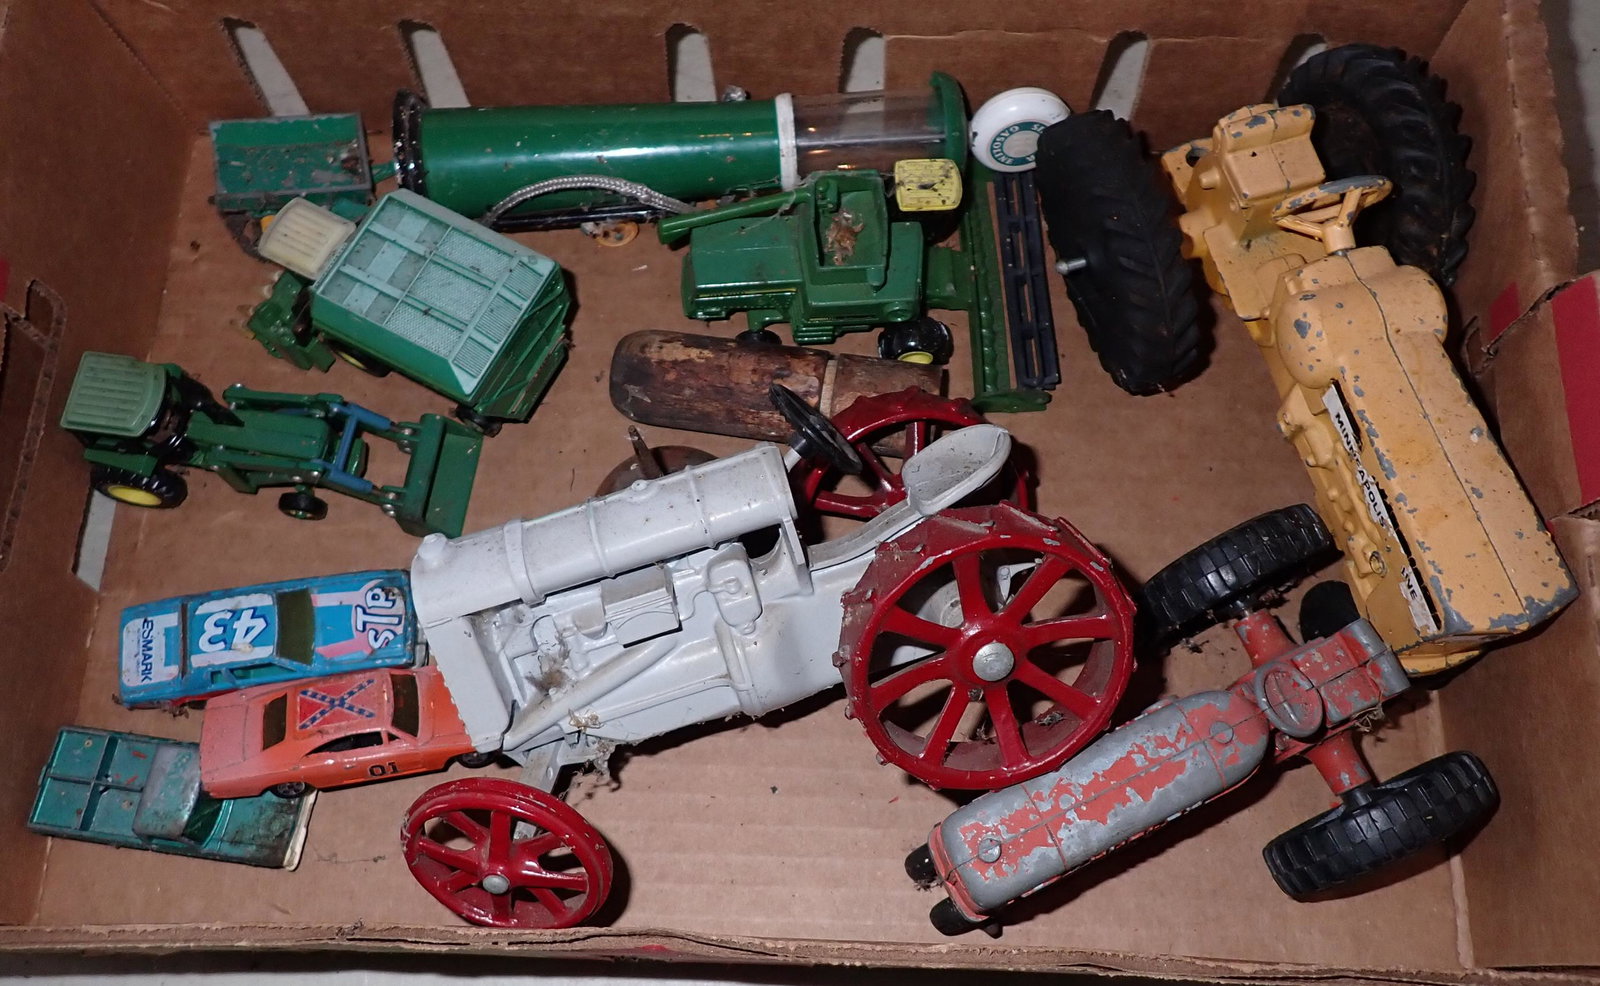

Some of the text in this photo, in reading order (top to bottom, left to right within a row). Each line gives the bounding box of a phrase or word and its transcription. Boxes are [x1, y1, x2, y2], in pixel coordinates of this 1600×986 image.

[199, 608, 268, 652] 43
[355, 588, 402, 650] STP
[139, 617, 155, 682] ESMARK
[369, 761, 399, 777] 01
